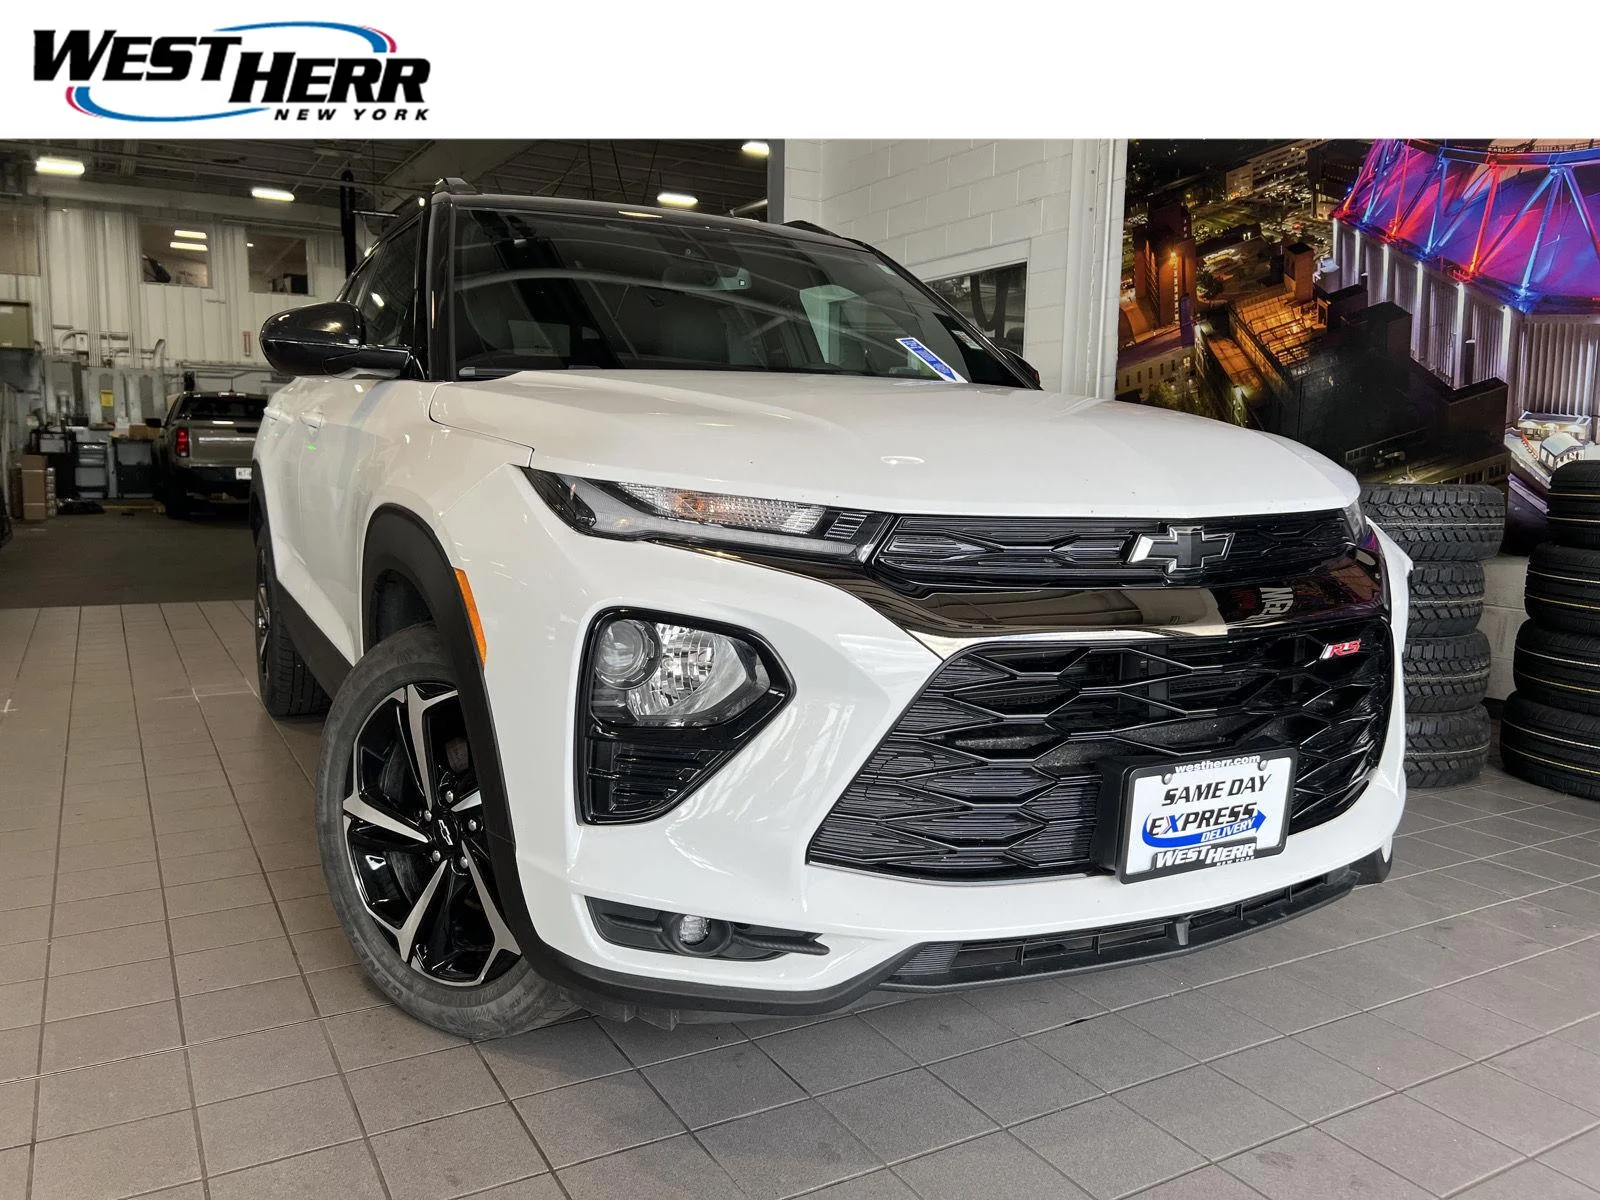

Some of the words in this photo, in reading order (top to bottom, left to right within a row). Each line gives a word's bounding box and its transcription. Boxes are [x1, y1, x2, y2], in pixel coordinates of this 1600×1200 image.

[1328, 639, 1362, 656] RS
[1174, 755, 1261, 773] westherr.com
[1161, 781, 1226, 807] SAME
[1227, 773, 1272, 797] DAY
[1148, 802, 1258, 836] EXPRESS
[1201, 818, 1256, 843] DELIVERY
